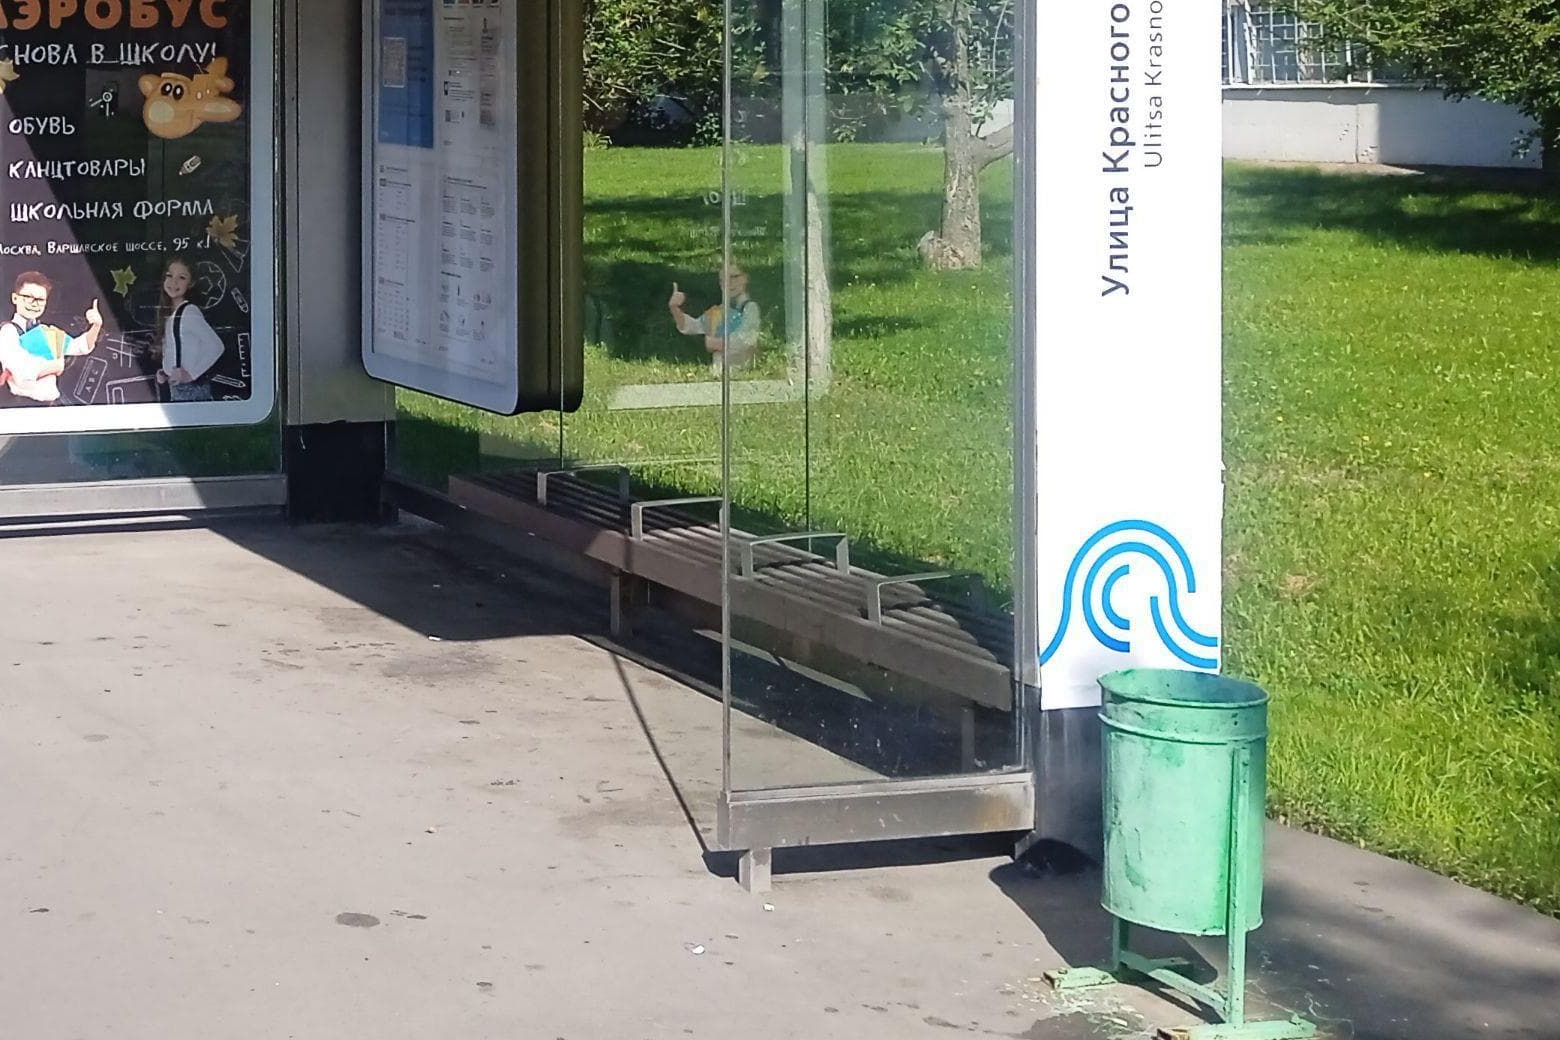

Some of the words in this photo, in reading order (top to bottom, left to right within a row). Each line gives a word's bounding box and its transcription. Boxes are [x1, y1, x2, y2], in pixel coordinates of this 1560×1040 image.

[91, 43, 105, 64] В
[120, 41, 216, 66] ШКОЛУ!
[1102, 3, 1136, 172] Красного
[9, 116, 75, 136] ОБУВЬ
[1143, 96, 1163, 167] Ulitsa
[9, 158, 145, 180] КАНЦТОВАРЫ
[10, 201, 123, 223] ШКОЛЬНАЯ
[133, 199, 214, 220] ФОРМА
[172, 237, 190, 251] 95
[1101, 187, 1134, 297] Улица
